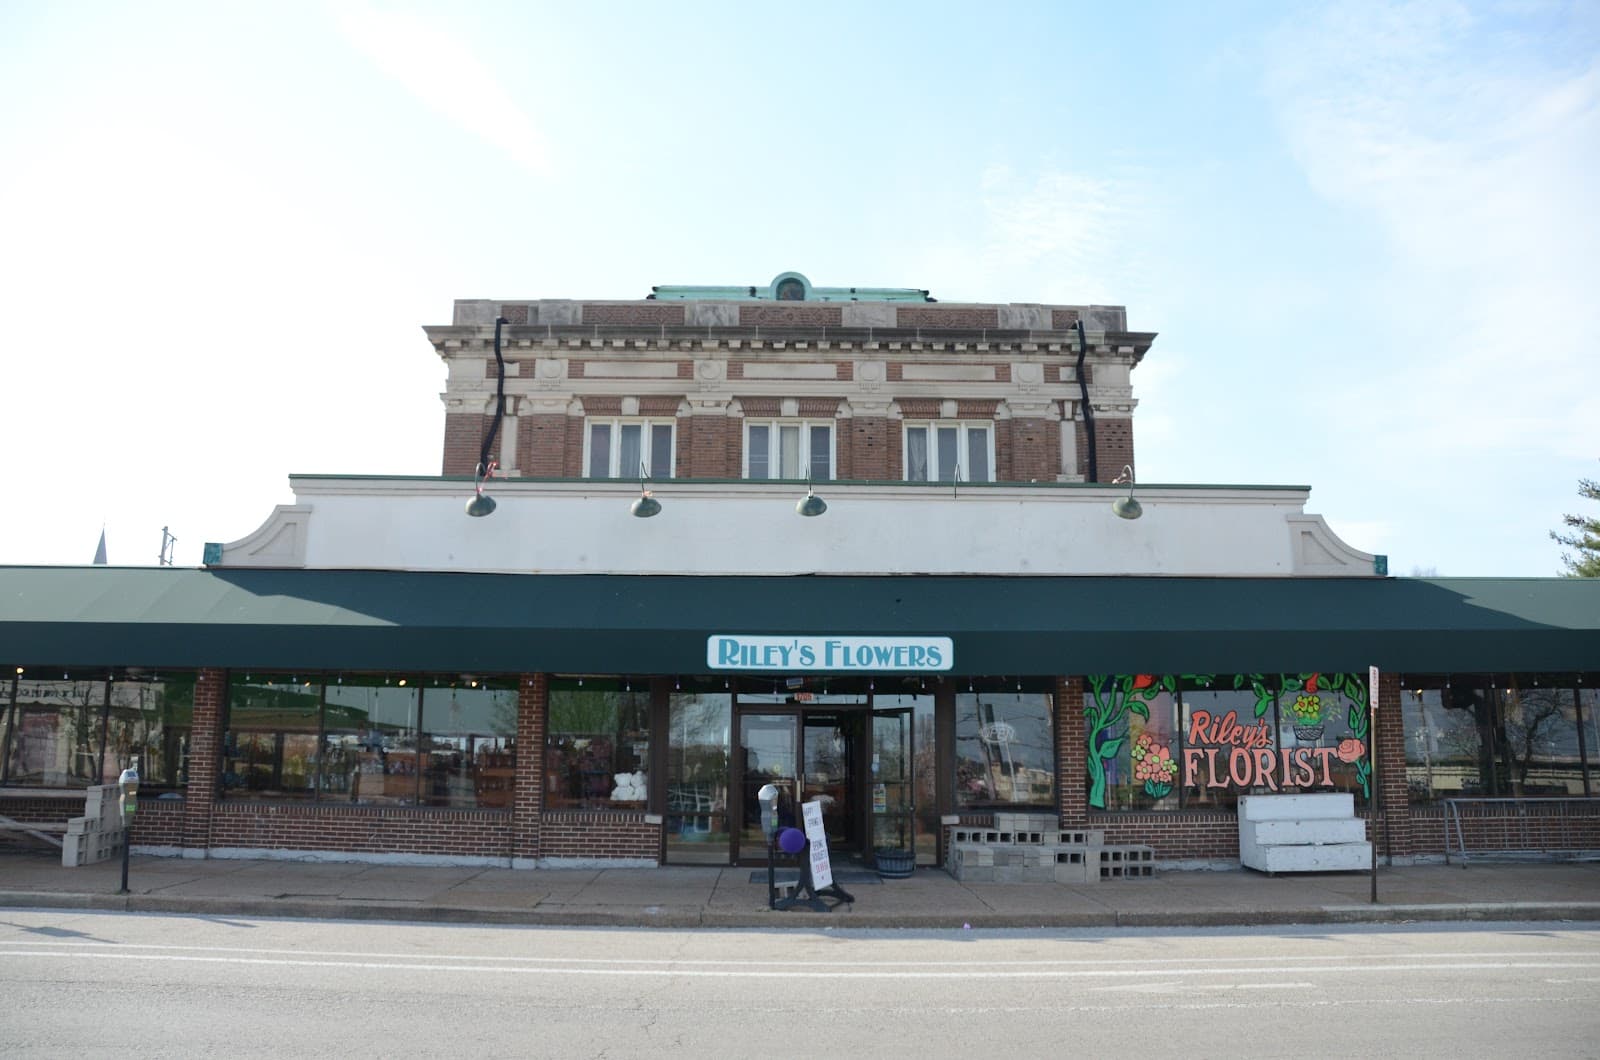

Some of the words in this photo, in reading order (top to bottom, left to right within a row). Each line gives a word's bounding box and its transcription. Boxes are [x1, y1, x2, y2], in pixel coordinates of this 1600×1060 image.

[718, 638, 816, 667] RILEY'S
[824, 640, 943, 667] FLOWERS
[1188, 710, 1274, 749] Riley's
[1184, 746, 1339, 792] FLORIST
